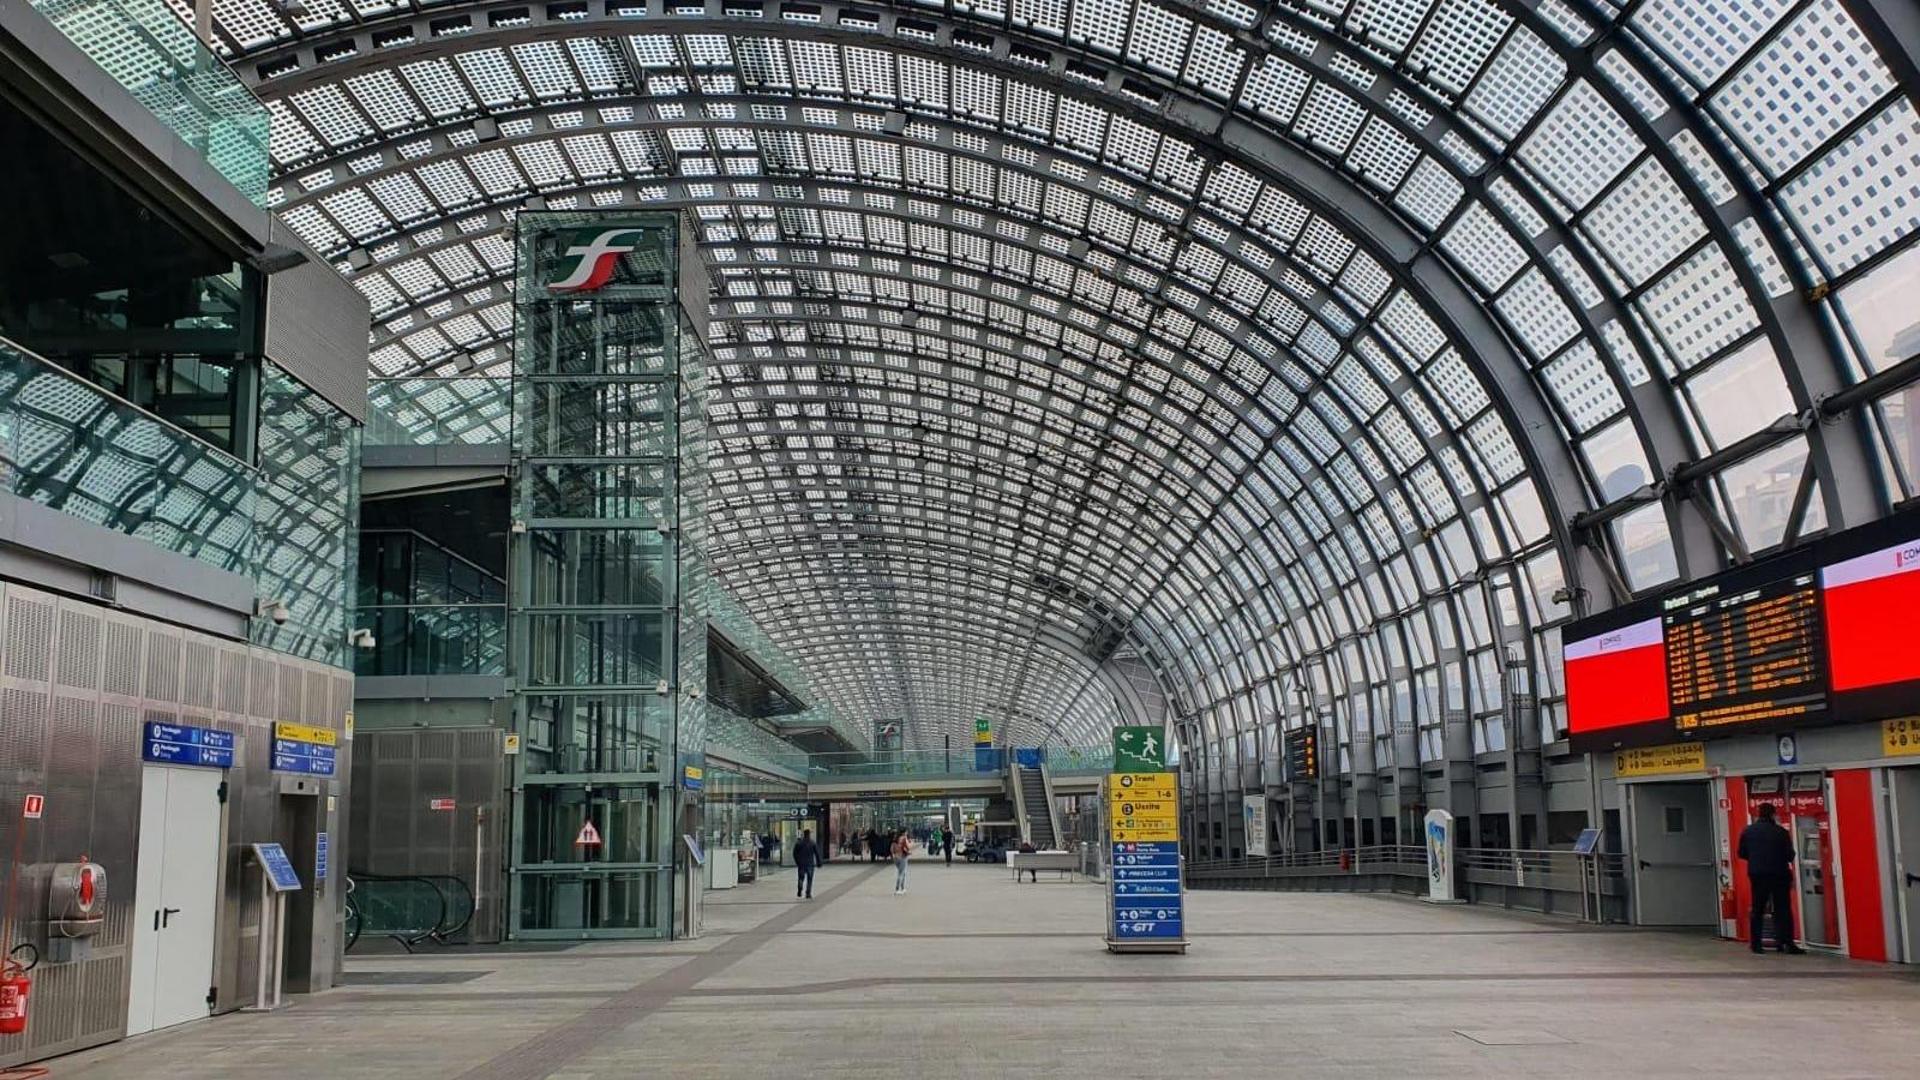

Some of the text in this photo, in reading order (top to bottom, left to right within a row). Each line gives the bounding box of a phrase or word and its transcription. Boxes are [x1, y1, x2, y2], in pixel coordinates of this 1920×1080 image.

[1617, 755, 1625, 771] D
[1134, 802, 1160, 810] Uscita
[1132, 922, 1156, 932] GTT
